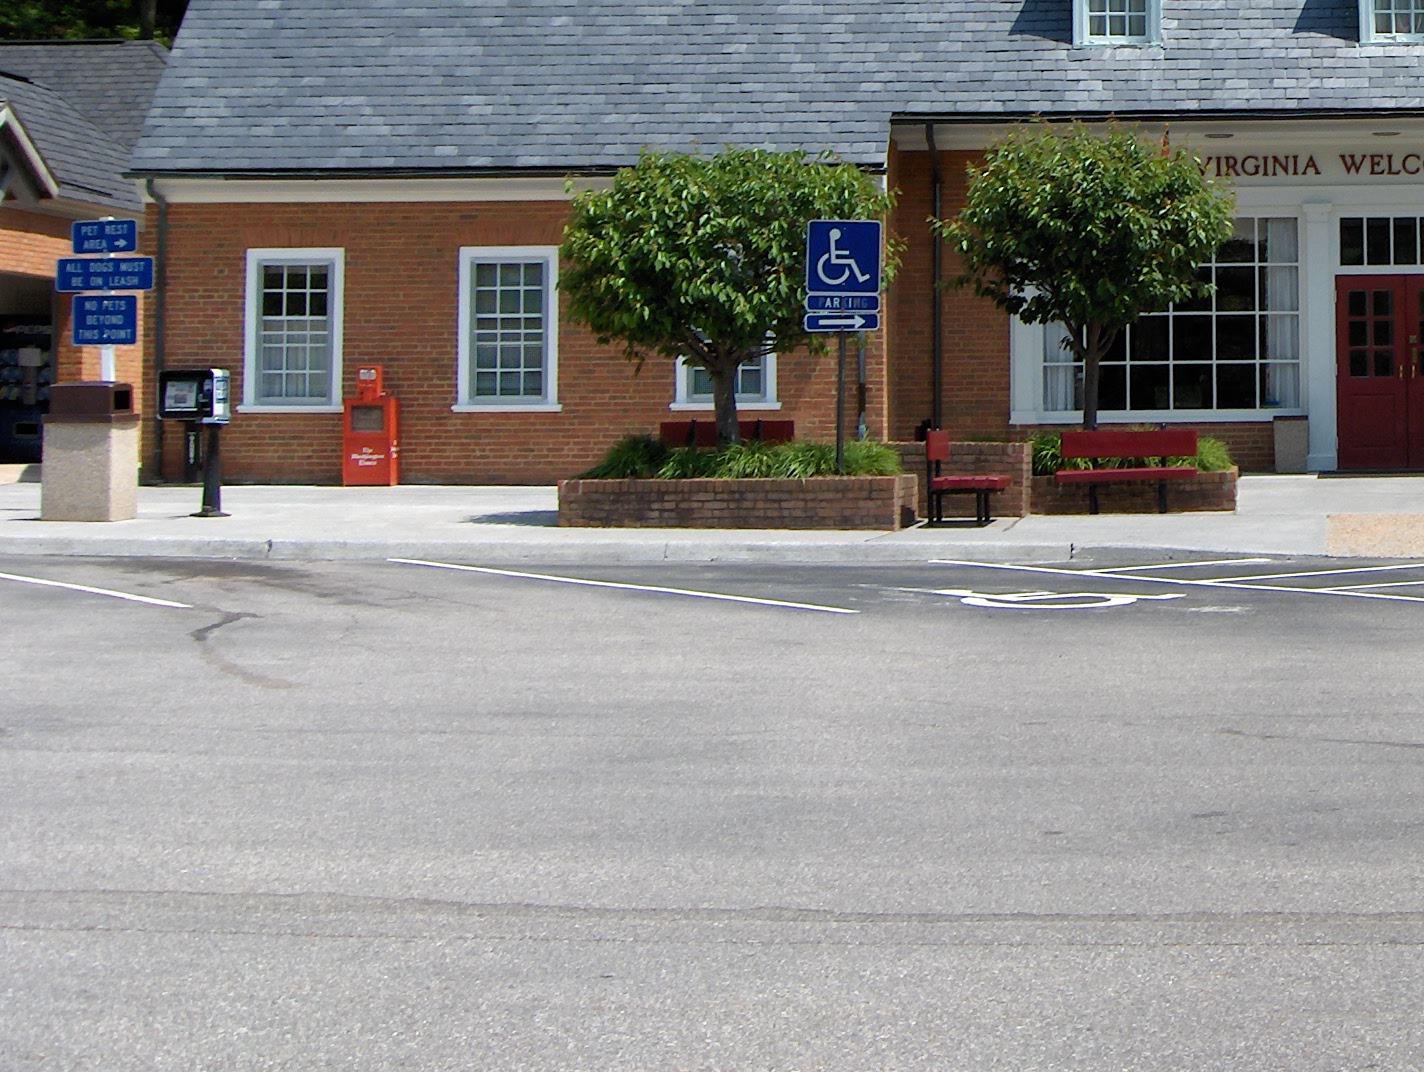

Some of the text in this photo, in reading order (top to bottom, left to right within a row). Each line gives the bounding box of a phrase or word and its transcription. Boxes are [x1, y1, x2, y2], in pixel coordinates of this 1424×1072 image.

[1197, 155, 1321, 177] VIRGINIA
[81, 224, 128, 236] PET REST
[83, 239, 107, 249] AREA
[66, 261, 145, 273] ALL DOGS MUST
[71, 275, 138, 286] BE ON LEASH
[84, 300, 126, 311] NO PETS
[86, 315, 124, 325] BEYOND
[78, 329, 132, 339] THIS POINT
